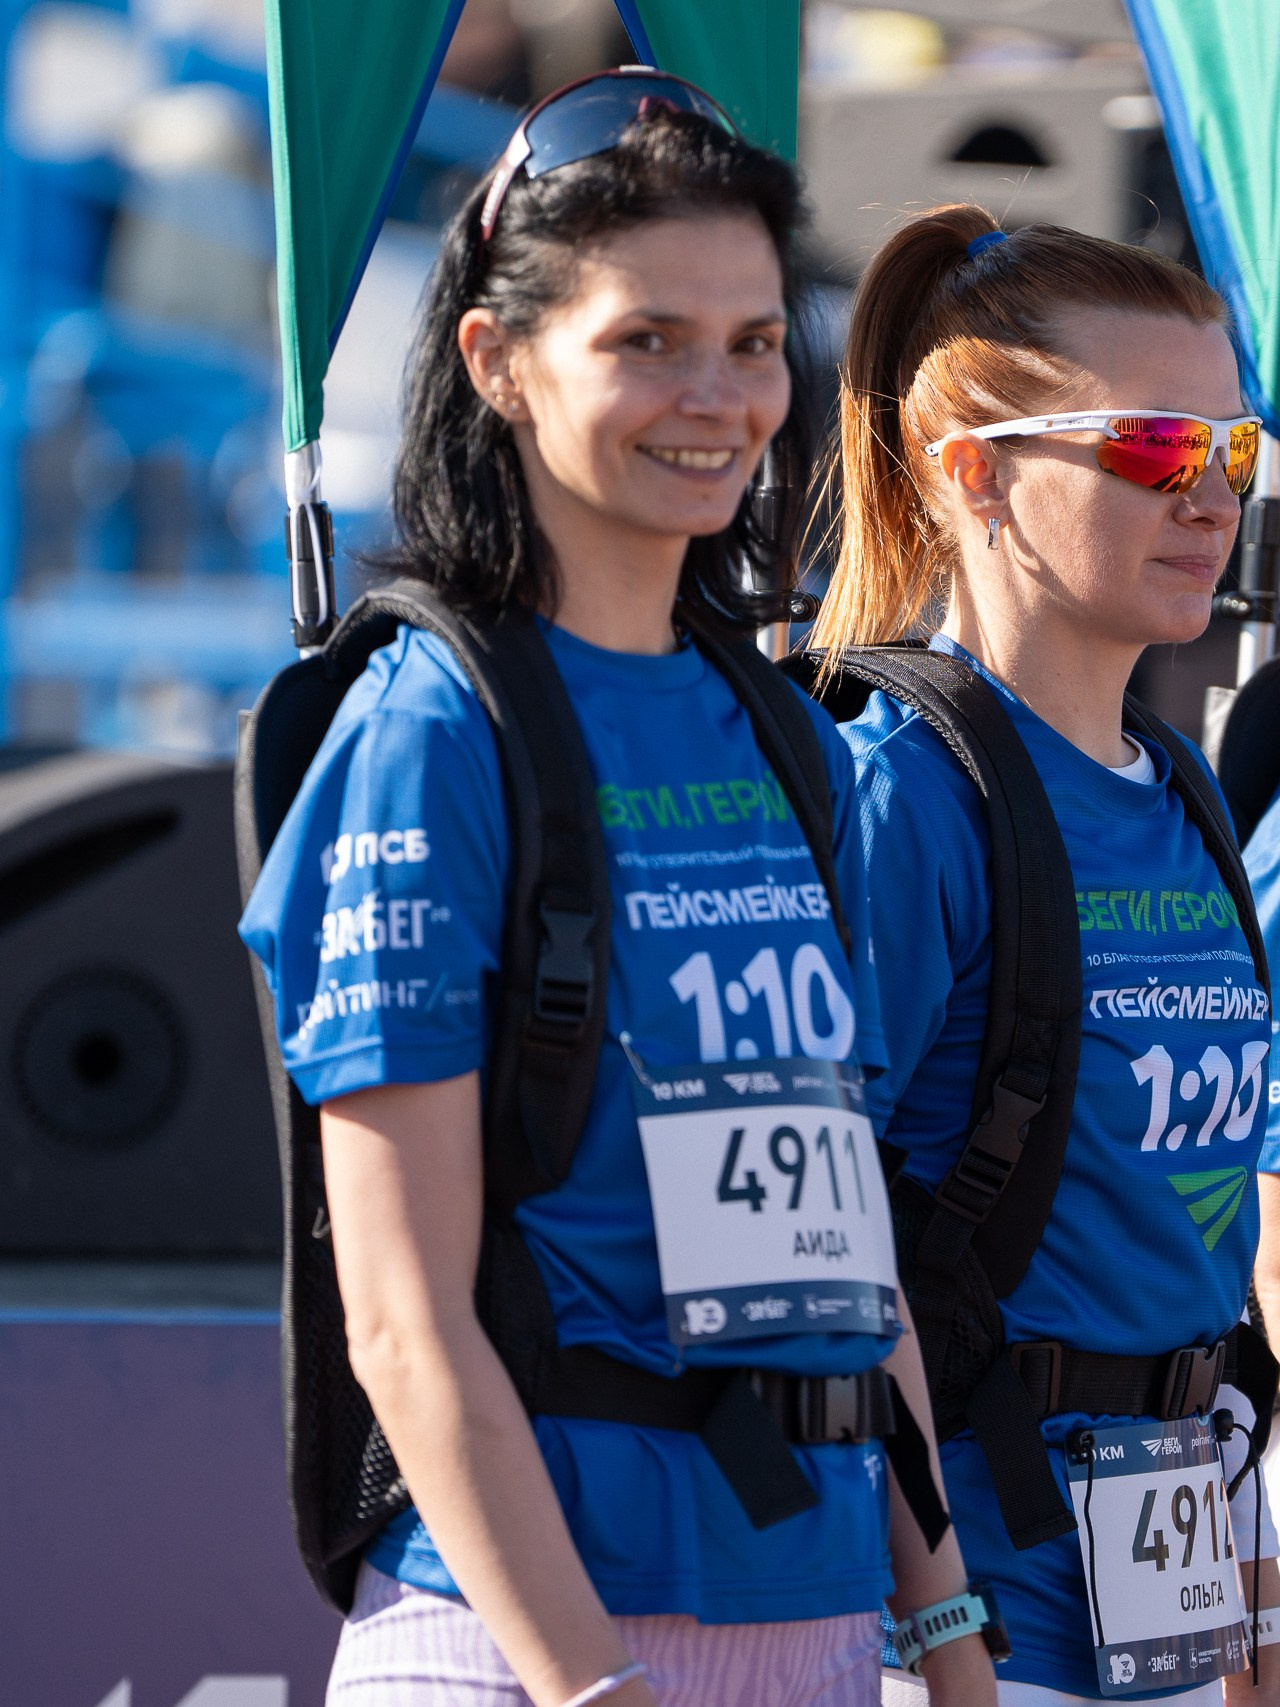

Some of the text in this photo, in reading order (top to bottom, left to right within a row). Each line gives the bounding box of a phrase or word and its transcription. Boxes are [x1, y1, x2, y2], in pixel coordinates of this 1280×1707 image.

[1087, 954, 1100, 967] 10
[668, 943, 856, 1064] 1:10
[1089, 976, 1270, 1021] ПЕЙСМЕЙКЕР
[1129, 1040, 1270, 1152] 1:10
[716, 1125, 867, 1215] 4911
[792, 1229, 851, 1263] АИДА
[1180, 1579, 1225, 1613] ОЛЬГА
